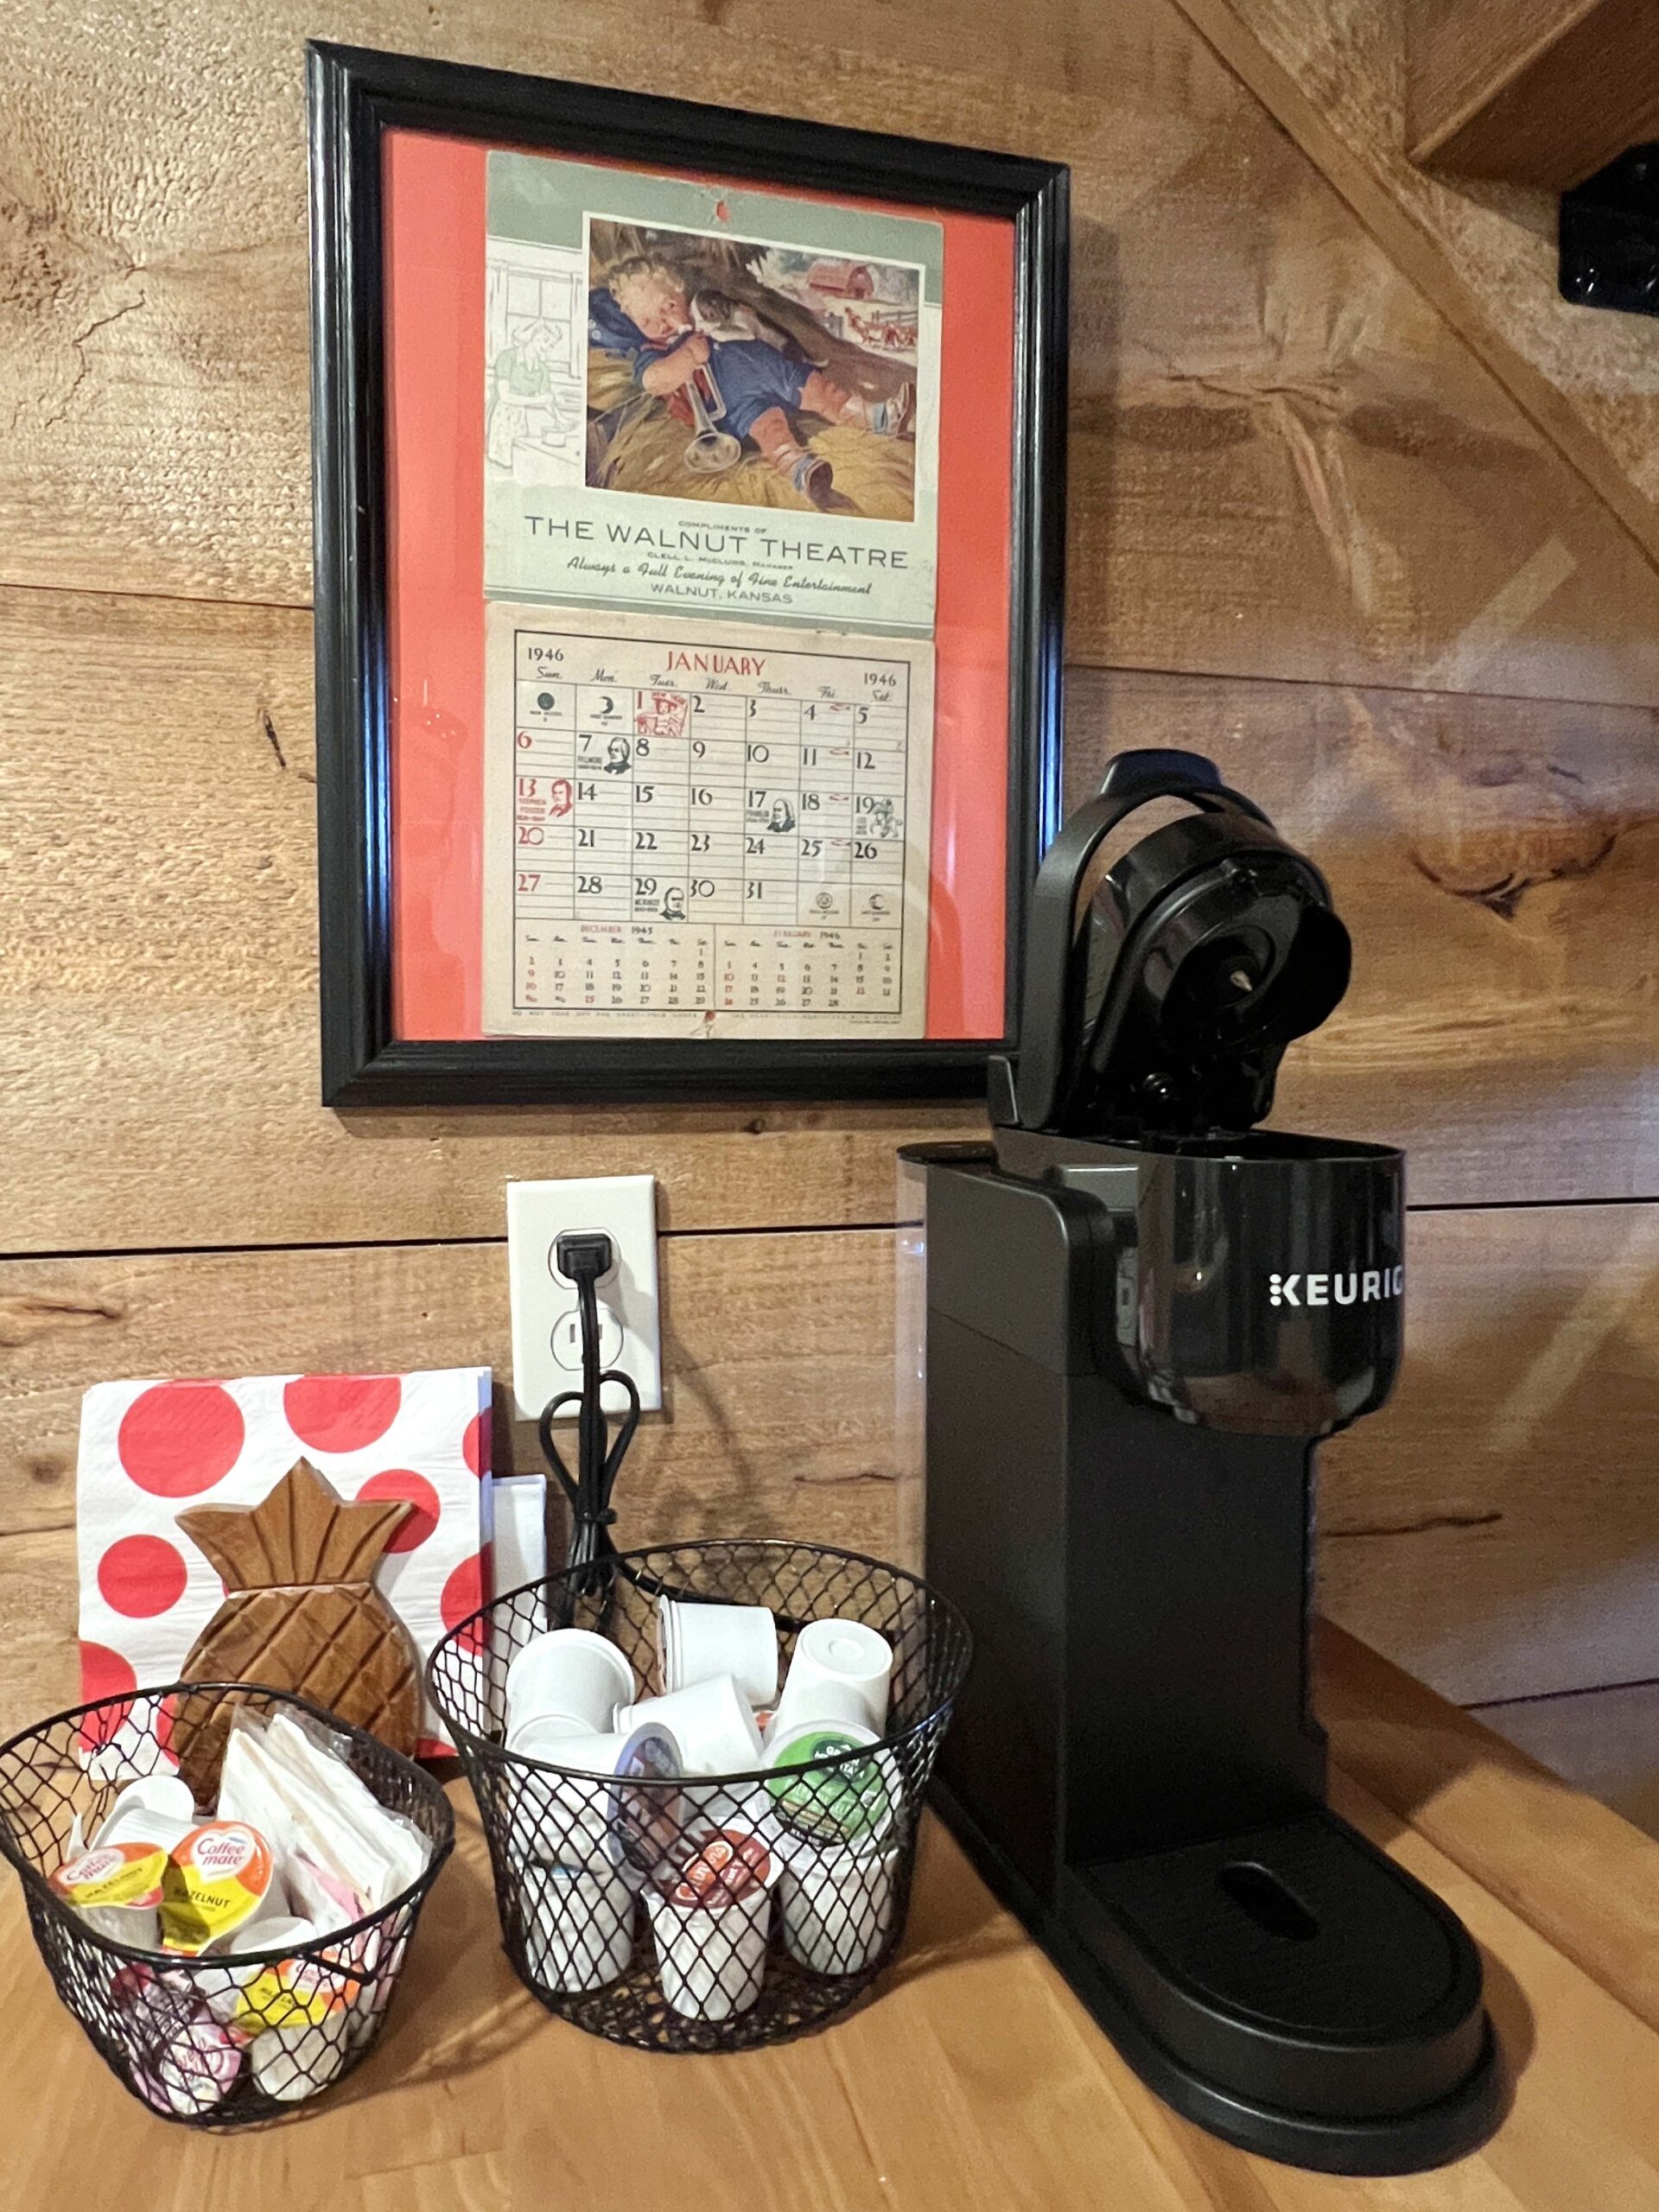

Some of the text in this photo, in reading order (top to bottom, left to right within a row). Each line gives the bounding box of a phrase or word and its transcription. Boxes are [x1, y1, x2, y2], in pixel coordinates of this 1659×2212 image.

[524, 515, 908, 569] THE WALNUT THEATRE
[678, 520, 750, 533] COMPLIMENTS
[567, 556, 616, 576] Always
[638, 562, 669, 577] Full
[673, 565, 726, 587] Evening
[730, 570, 744, 588] of
[748, 572, 779, 587] Fine
[783, 575, 873, 594] Entertainment
[651, 583, 793, 603] WALNUT, KANSAS
[528, 647, 897, 687] 1946 JANUARY 1946
[637, 690, 869, 724] 1 2 3 4 5
[518, 731, 875, 769] 6 7 8 9 10 11 12
[518, 778, 875, 814] 13 14 15 16 17 18 19
[518, 826, 878, 860] 20 21 22 23 24 25 26
[518, 874, 762, 899] 27 28 29 30 31
[197, 1837, 245, 1857] Coffee
[203, 1853, 244, 1866] mate
[175, 1886, 231, 1909] HAZELNUT
